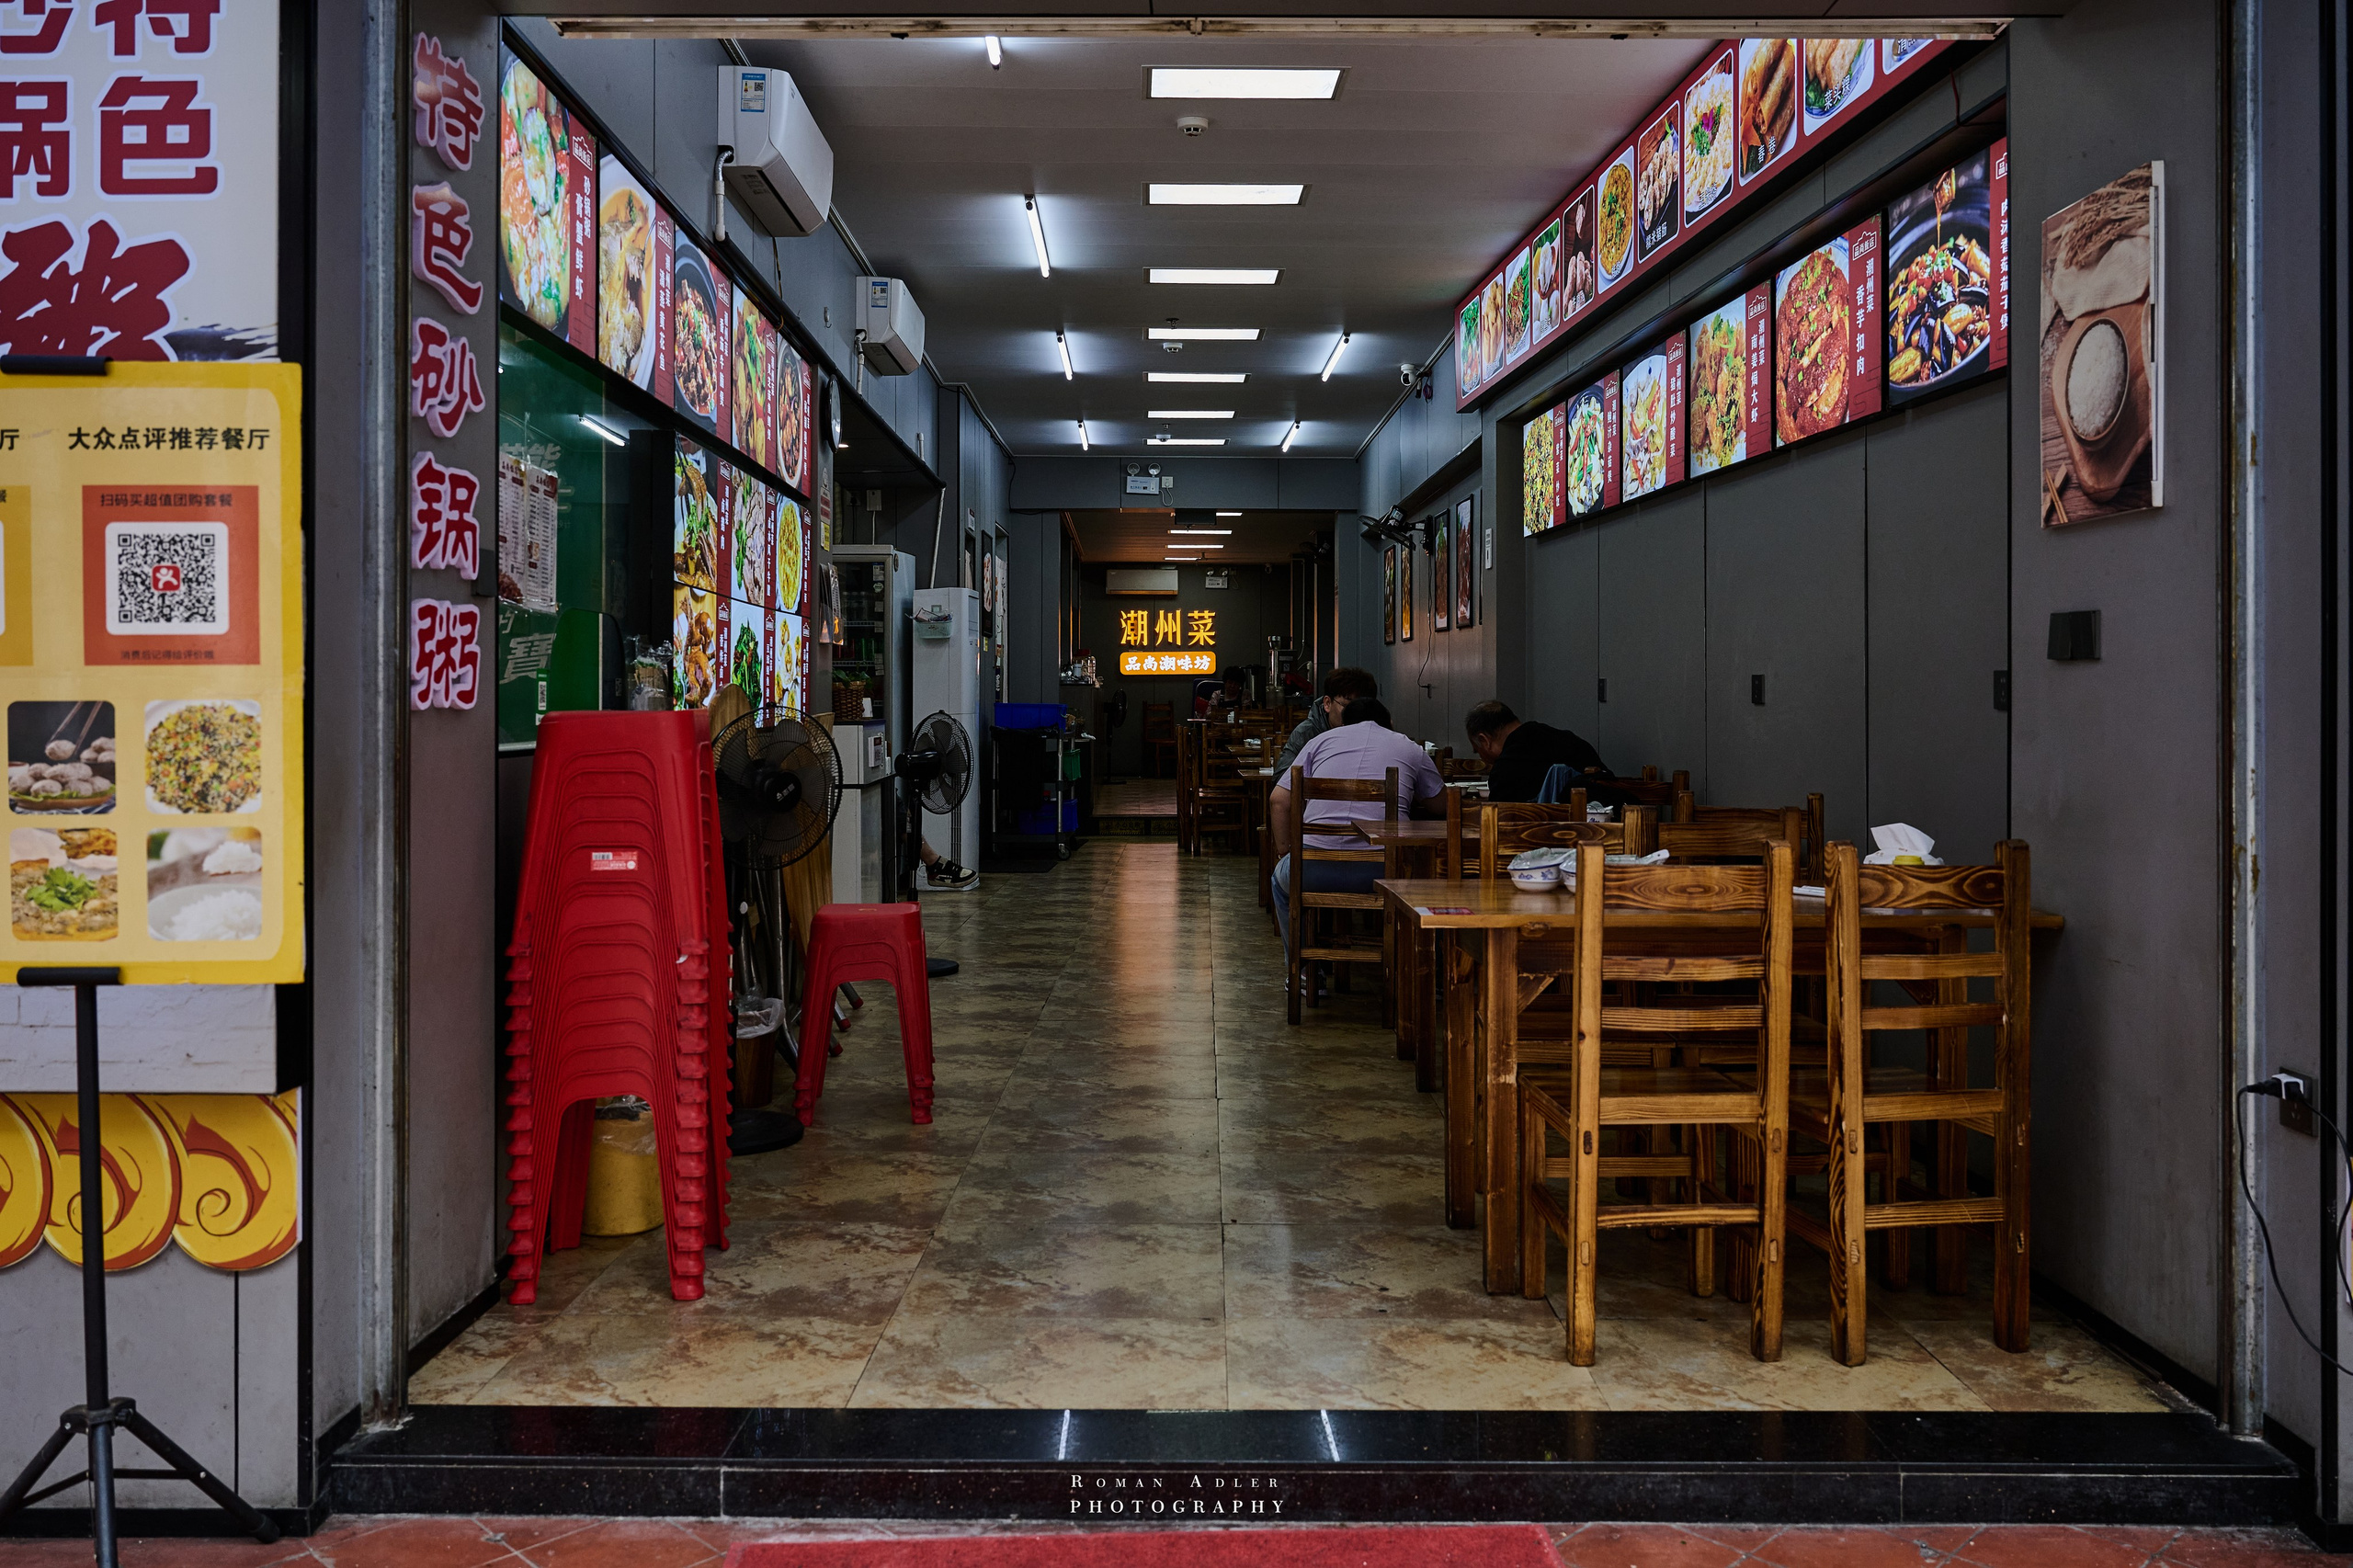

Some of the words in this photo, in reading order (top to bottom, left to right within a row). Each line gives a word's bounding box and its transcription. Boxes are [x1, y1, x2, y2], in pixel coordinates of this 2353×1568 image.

[1756, 136, 1776, 163] 春卷
[583, 173, 591, 240] 砂锅粥
[1865, 256, 1874, 313] 潮州菜
[1856, 283, 1865, 377] 香芋扣肉
[411, 32, 486, 710] 特色砂锅粥
[68, 426, 270, 450] 大众点评推荐餐厅
[101, 493, 233, 507] 扫码买超值团购套餐
[1120, 608, 1216, 646] 潮州菜
[1125, 655, 1211, 672] 品尚潮味坊
